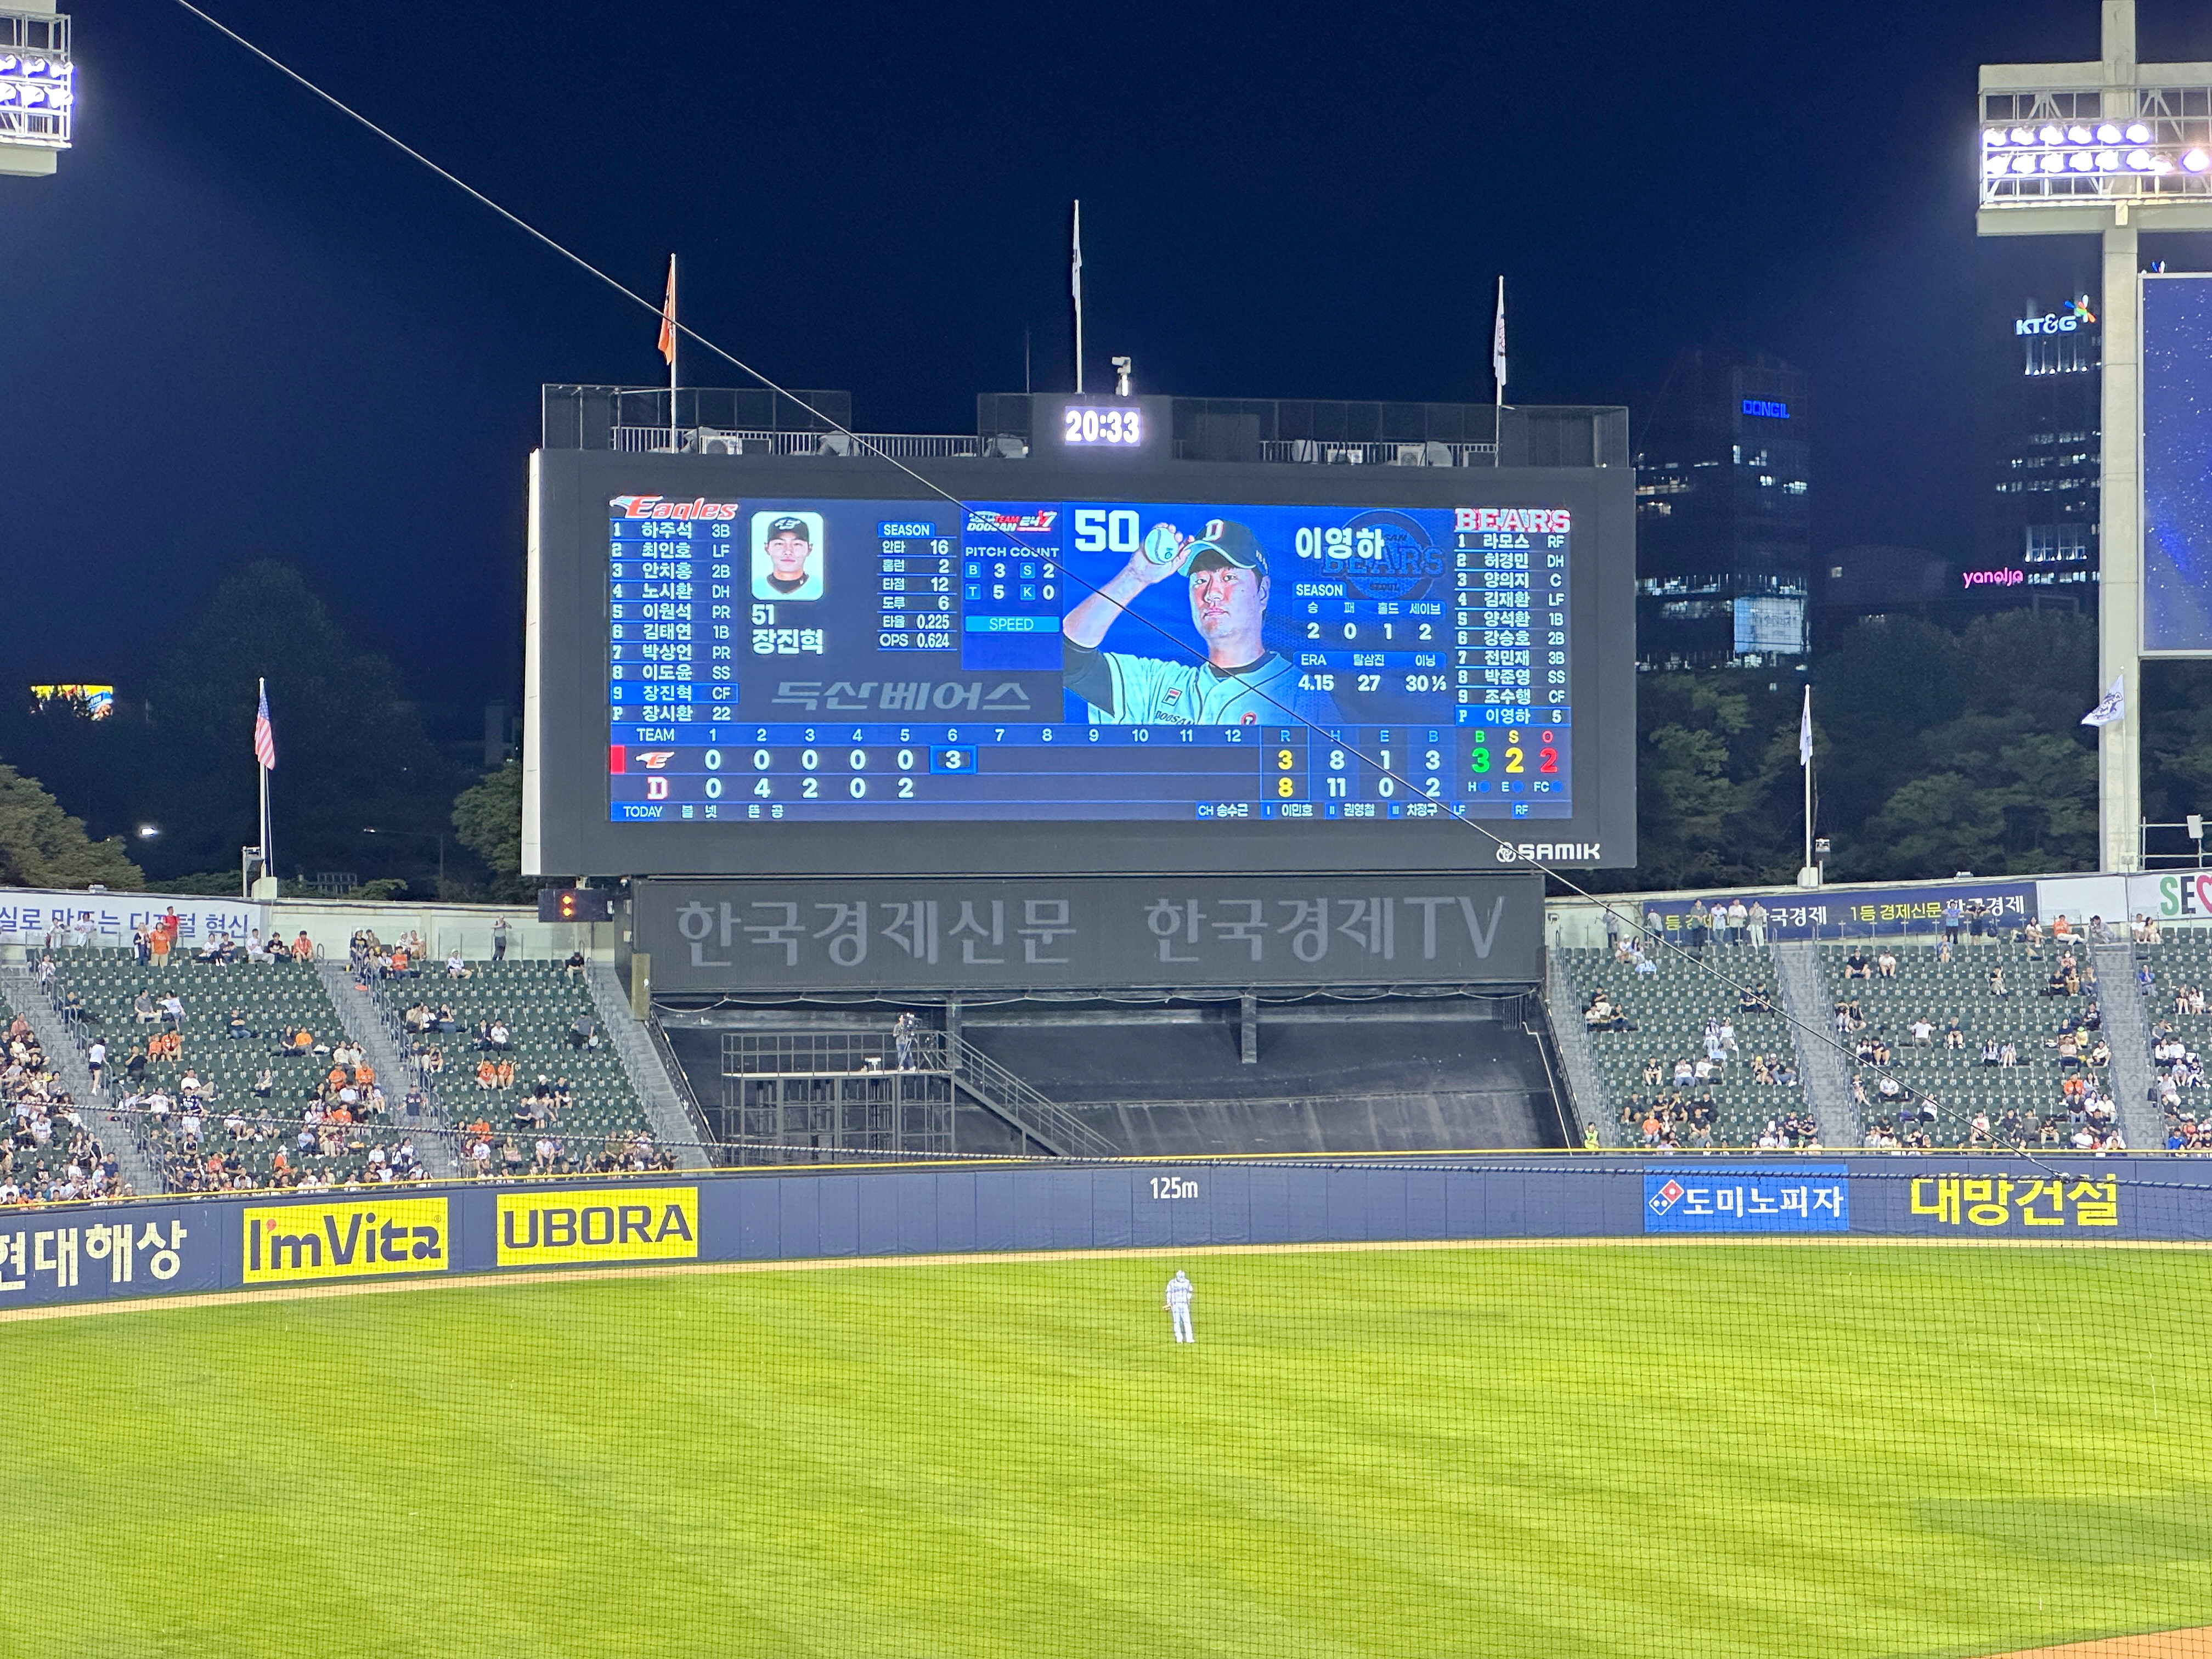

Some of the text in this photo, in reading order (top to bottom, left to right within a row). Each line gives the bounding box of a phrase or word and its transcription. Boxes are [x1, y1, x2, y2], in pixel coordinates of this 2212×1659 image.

[2016, 313, 2077, 335] KT&G
[1066, 410, 1139, 443] 20:33
[625, 495, 738, 521] Eagles
[1455, 509, 1571, 533] BEARS
[642, 522, 730, 538] 하주석 3B
[884, 524, 929, 535] SEASON
[1075, 510, 1139, 552] 50
[883, 539, 949, 555] 안타 16
[1295, 527, 1385, 560] 이영하
[1484, 533, 1564, 549] 라모스 RF
[642, 542, 730, 558] 최인호 LF
[966, 547, 1059, 557] PITCH COUNT
[939, 559, 949, 573] 2
[1484, 552, 1564, 569] 허경민 DH
[642, 562, 730, 579] 안치홍 2B
[969, 563, 1054, 578] B 3 S 2
[1963, 567, 2023, 588] yanolja
[883, 578, 949, 591] 타점 12
[1484, 572, 1561, 588] 양의지 C
[642, 583, 730, 600] 노시환 DH
[969, 585, 1054, 600] T 5 K 0
[1296, 584, 1343, 596] SEASON
[883, 596, 949, 610] 도루 6
[1484, 591, 1564, 608] 김재환 LF
[642, 604, 730, 620] 이원석 PR
[752, 605, 775, 625] 51
[1308, 602, 1318, 614] 승
[1344, 602, 1355, 613] 패
[1409, 603, 1441, 615] 세이브
[883, 614, 949, 629] 타율 0.225
[990, 618, 1034, 630] SPEED
[1484, 611, 1564, 627] 양석환 1B
[642, 624, 730, 641] 김태연 1B
[1307, 622, 1431, 640] 2 0 1 2
[1484, 630, 1564, 646] 강승호 2B
[752, 629, 823, 654] 장진혁
[879, 633, 949, 648] OPS 0.624
[642, 644, 730, 661] 박상언 PR
[1301, 654, 1435, 667] ERA 탈삼진 이닝
[1484, 650, 1565, 666] 전민재 3B
[642, 665, 730, 681] 이도윤 SS
[1484, 670, 1565, 685] 박준영 SS
[1299, 674, 1334, 691] 4.15
[1357, 675, 1380, 691] 27
[642, 685, 730, 701] 장진혁 CF
[1484, 689, 1565, 704] 조수행 CF
[642, 705, 730, 722] 장시환 22
[1484, 708, 1561, 724] 이영하 5
[636, 729, 1438, 742] TEAM R E B
[1476, 730, 1553, 743] B S O
[705, 750, 1440, 770] 0 0 0 0 0 3 3 8 1 3
[1472, 747, 1558, 773] 3 2 2
[705, 778, 1441, 798] 0 4 2 0 2 8 11 0 2
[1469, 782, 1549, 792] H E FC
[623, 806, 662, 817] TODAY
[1198, 803, 1248, 817] CH 송수근
[1282, 804, 1312, 816] 이민호
[1407, 804, 1437, 816] 차정구
[1515, 805, 1528, 815] RF
[1517, 844, 1600, 860] SAMIK
[1850, 905, 1875, 921] 1등
[1880, 902, 1942, 920] 경제신문
[1, 906, 42, 932] 실로
[206, 913, 247, 938] 혁신
[1144, 897, 1505, 962] 한국경제TV
[676, 900, 1076, 967] 한국경제신문
[1150, 1177, 1198, 1199] 125m
[1683, 1186, 1844, 1217] 도미노피자
[1911, 1173, 2118, 1226] 대방건설
[504, 1205, 692, 1249] UBORA
